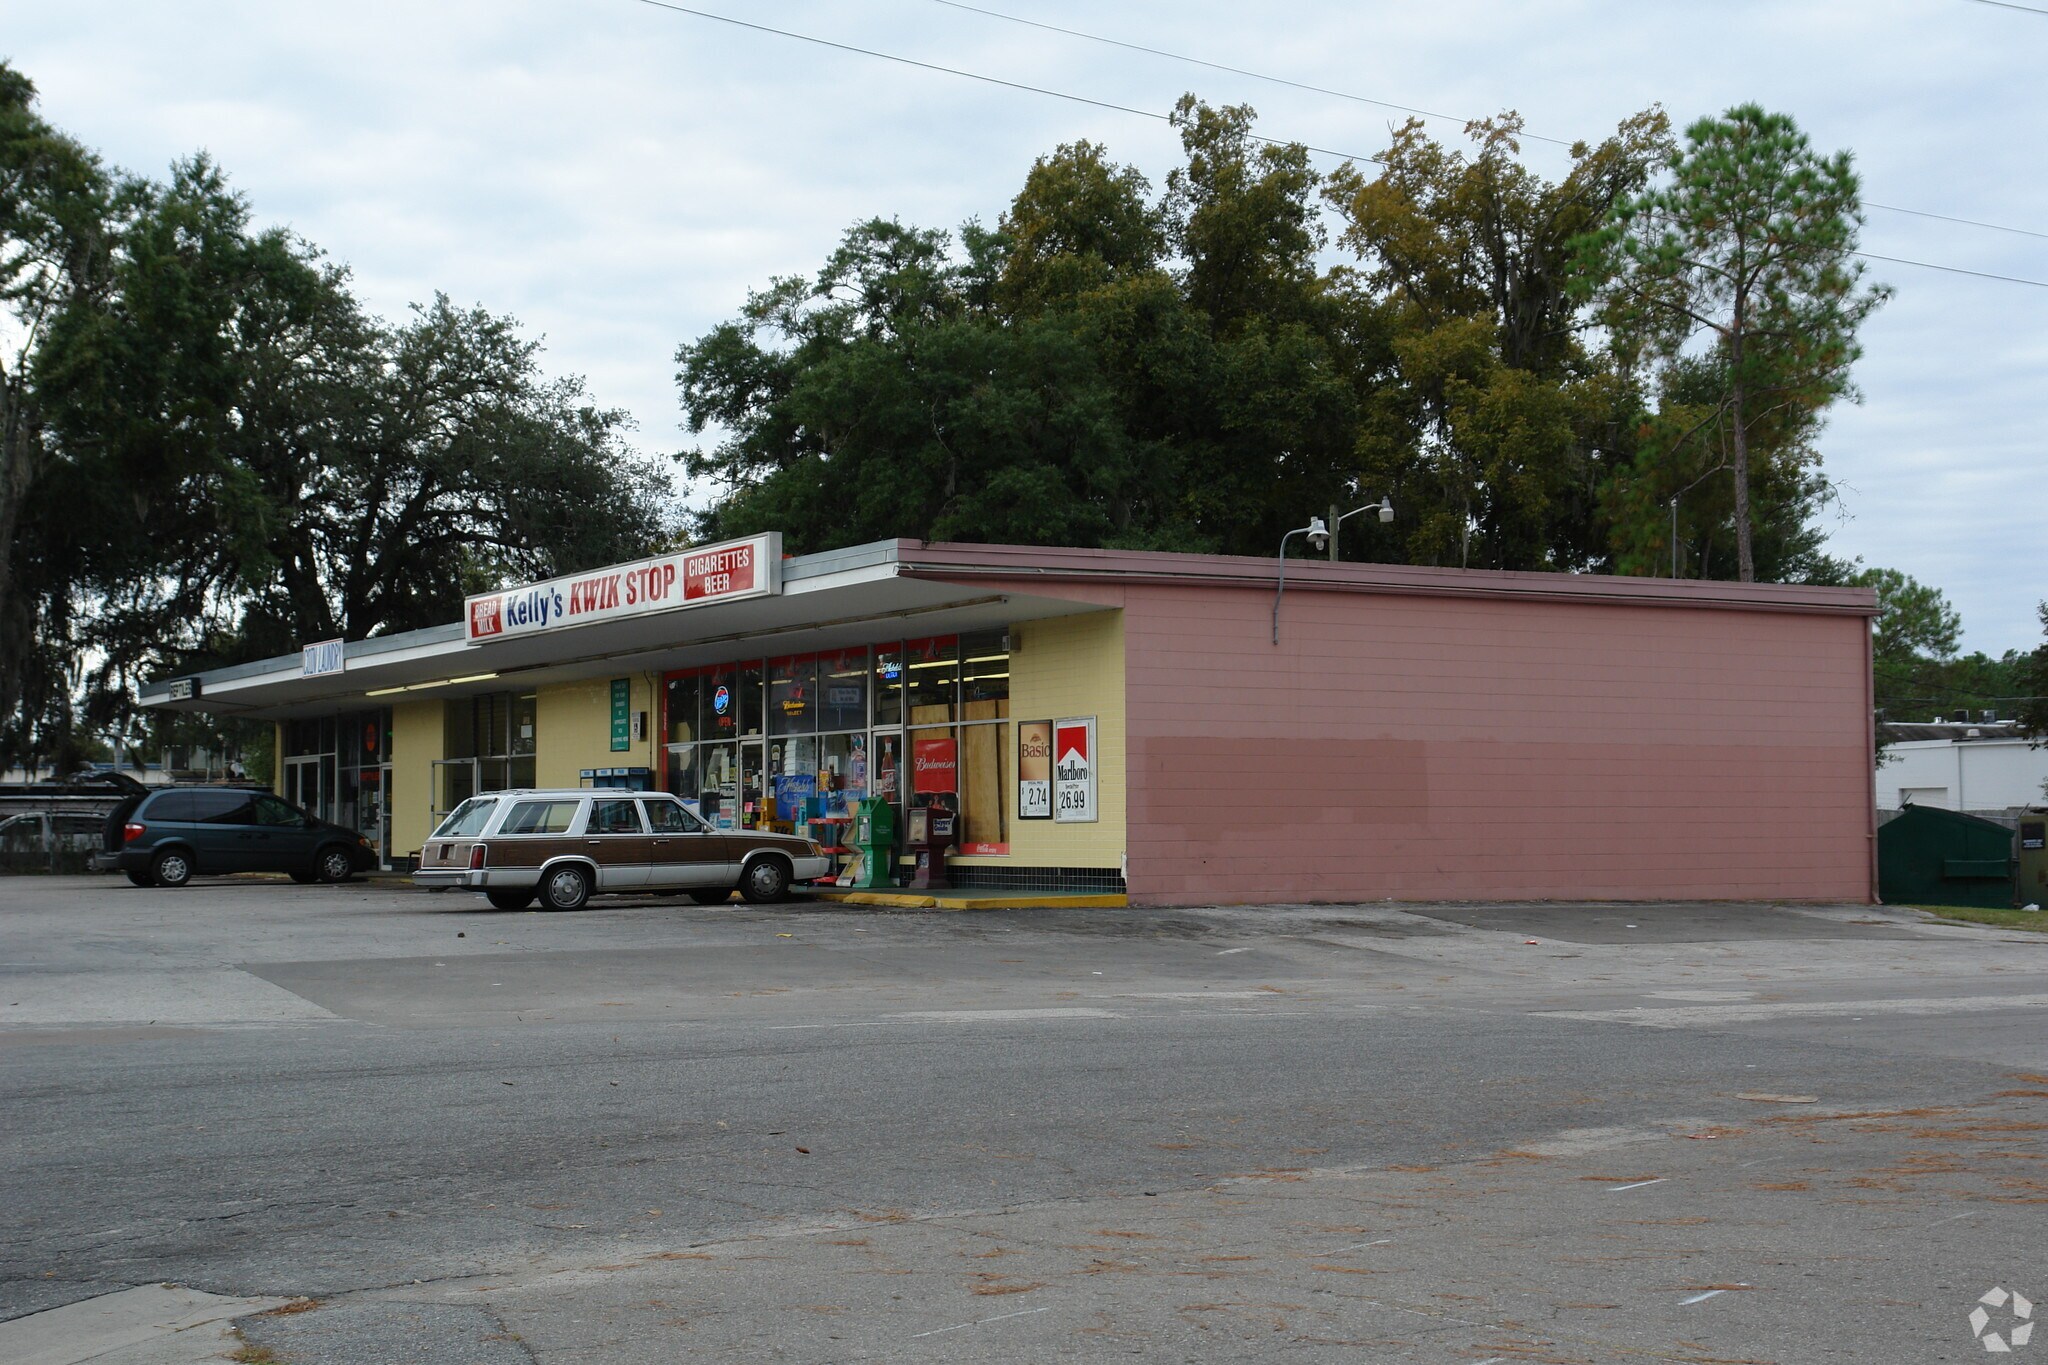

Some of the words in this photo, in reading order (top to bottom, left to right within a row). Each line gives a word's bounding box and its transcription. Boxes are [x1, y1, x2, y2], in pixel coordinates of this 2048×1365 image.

[688, 548, 750, 577] CIGARETTES
[704, 573, 730, 594] BEER
[507, 587, 563, 627] Kelly's
[569, 574, 621, 615] KWIK
[626, 563, 675, 605] STOP
[474, 600, 497, 617] BREAD
[476, 617, 495, 635] MILK
[170, 681, 192, 698] REPTILES
[718, 716, 731, 727] OPEN
[1021, 742, 1051, 758] Basic
[915, 757, 955, 771] Budweiser
[1057, 760, 1088, 781] Marlboro
[1028, 787, 1047, 806] 2.74
